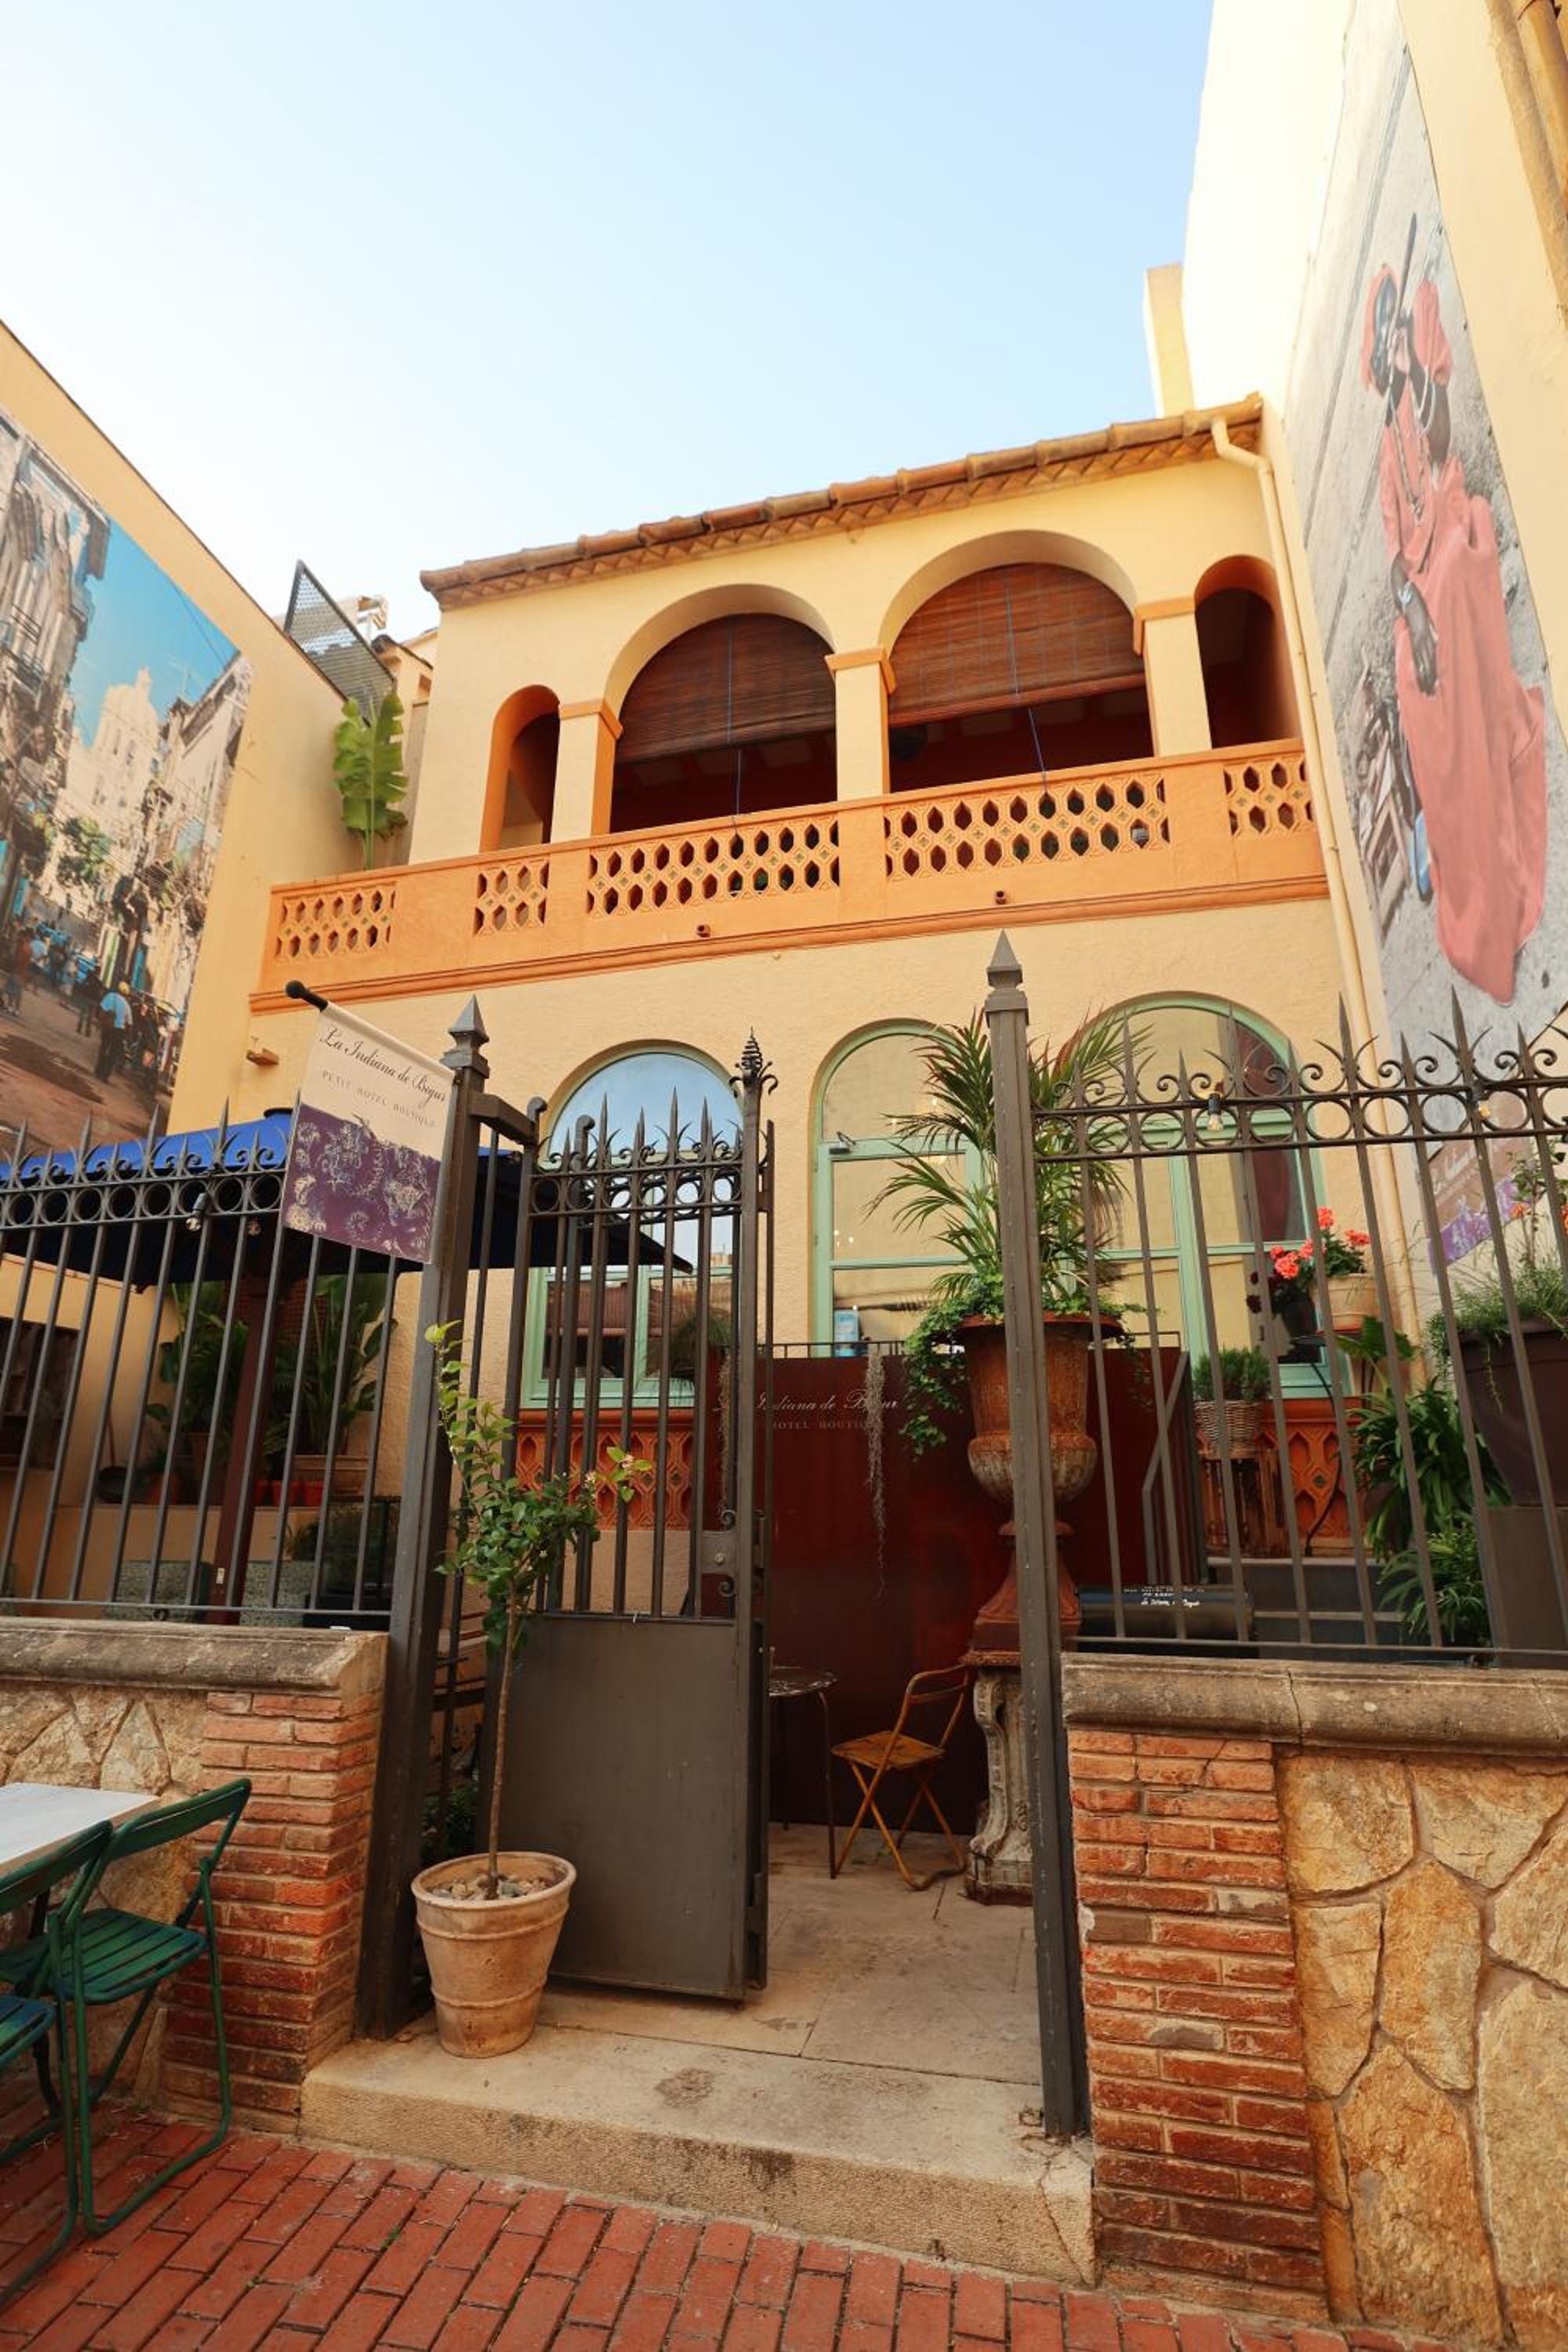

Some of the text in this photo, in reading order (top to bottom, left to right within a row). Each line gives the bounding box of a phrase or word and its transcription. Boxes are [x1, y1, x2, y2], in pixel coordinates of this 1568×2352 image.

[319, 1028, 446, 1109] La Indiana de Begur
[357, 1087, 387, 1105] HOTEL
[757, 1388, 897, 1413] Idiana de Bur
